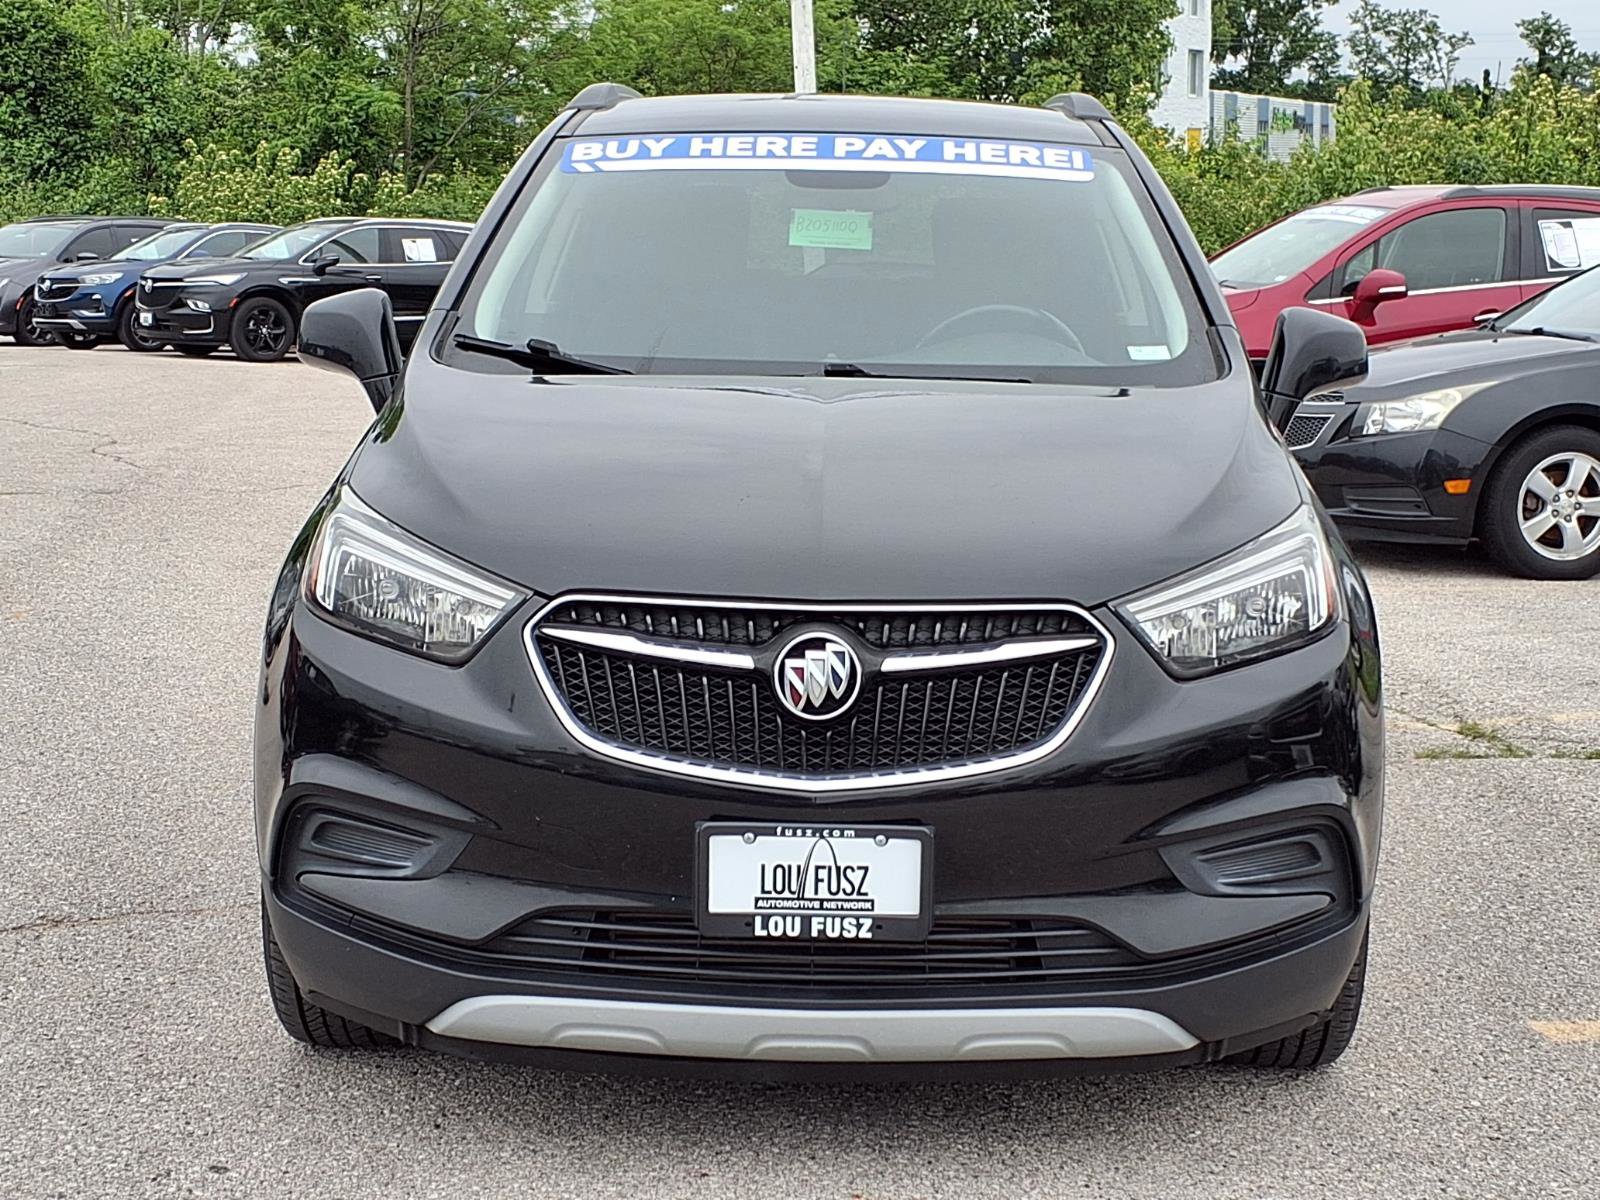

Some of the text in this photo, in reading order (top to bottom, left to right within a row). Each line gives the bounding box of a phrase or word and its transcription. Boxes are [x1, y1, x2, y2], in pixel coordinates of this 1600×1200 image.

[571, 137, 676, 161] BUY
[689, 136, 818, 157] HERE
[833, 137, 927, 160] PAY
[776, 826, 856, 838] fusz.com
[760, 863, 869, 897] LOU FUSZ
[757, 899, 872, 910] AUTOMOTIVE NETWORK
[754, 915, 873, 939] LOU FUSZ
